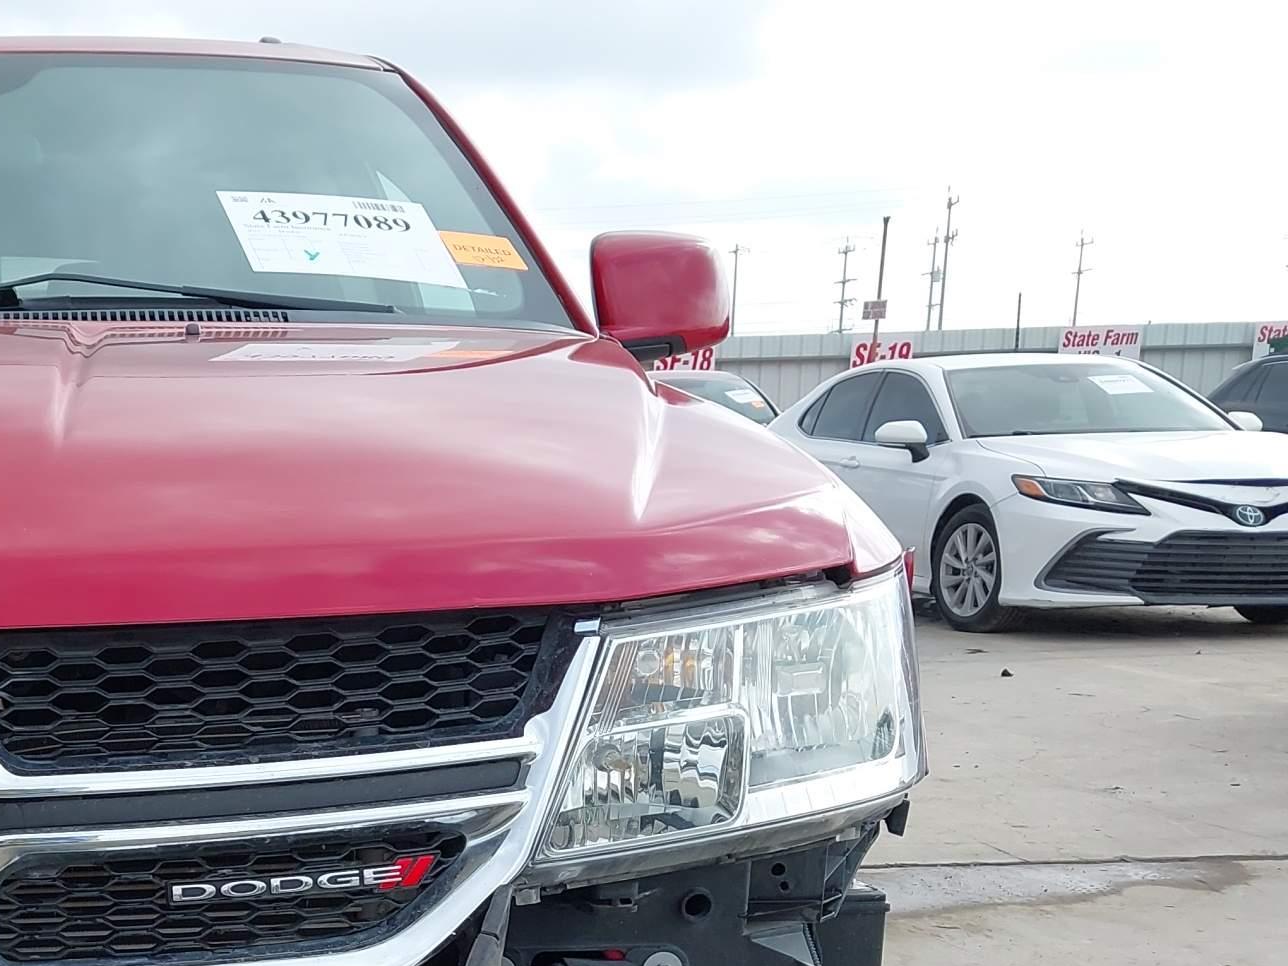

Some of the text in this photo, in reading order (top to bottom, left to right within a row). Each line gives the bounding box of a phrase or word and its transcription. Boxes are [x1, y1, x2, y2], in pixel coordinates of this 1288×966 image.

[252, 209, 411, 233] 43977089
[453, 244, 511, 256] DETAILED
[1063, 329, 1139, 348] State Farm
[172, 865, 402, 901] DODGE
